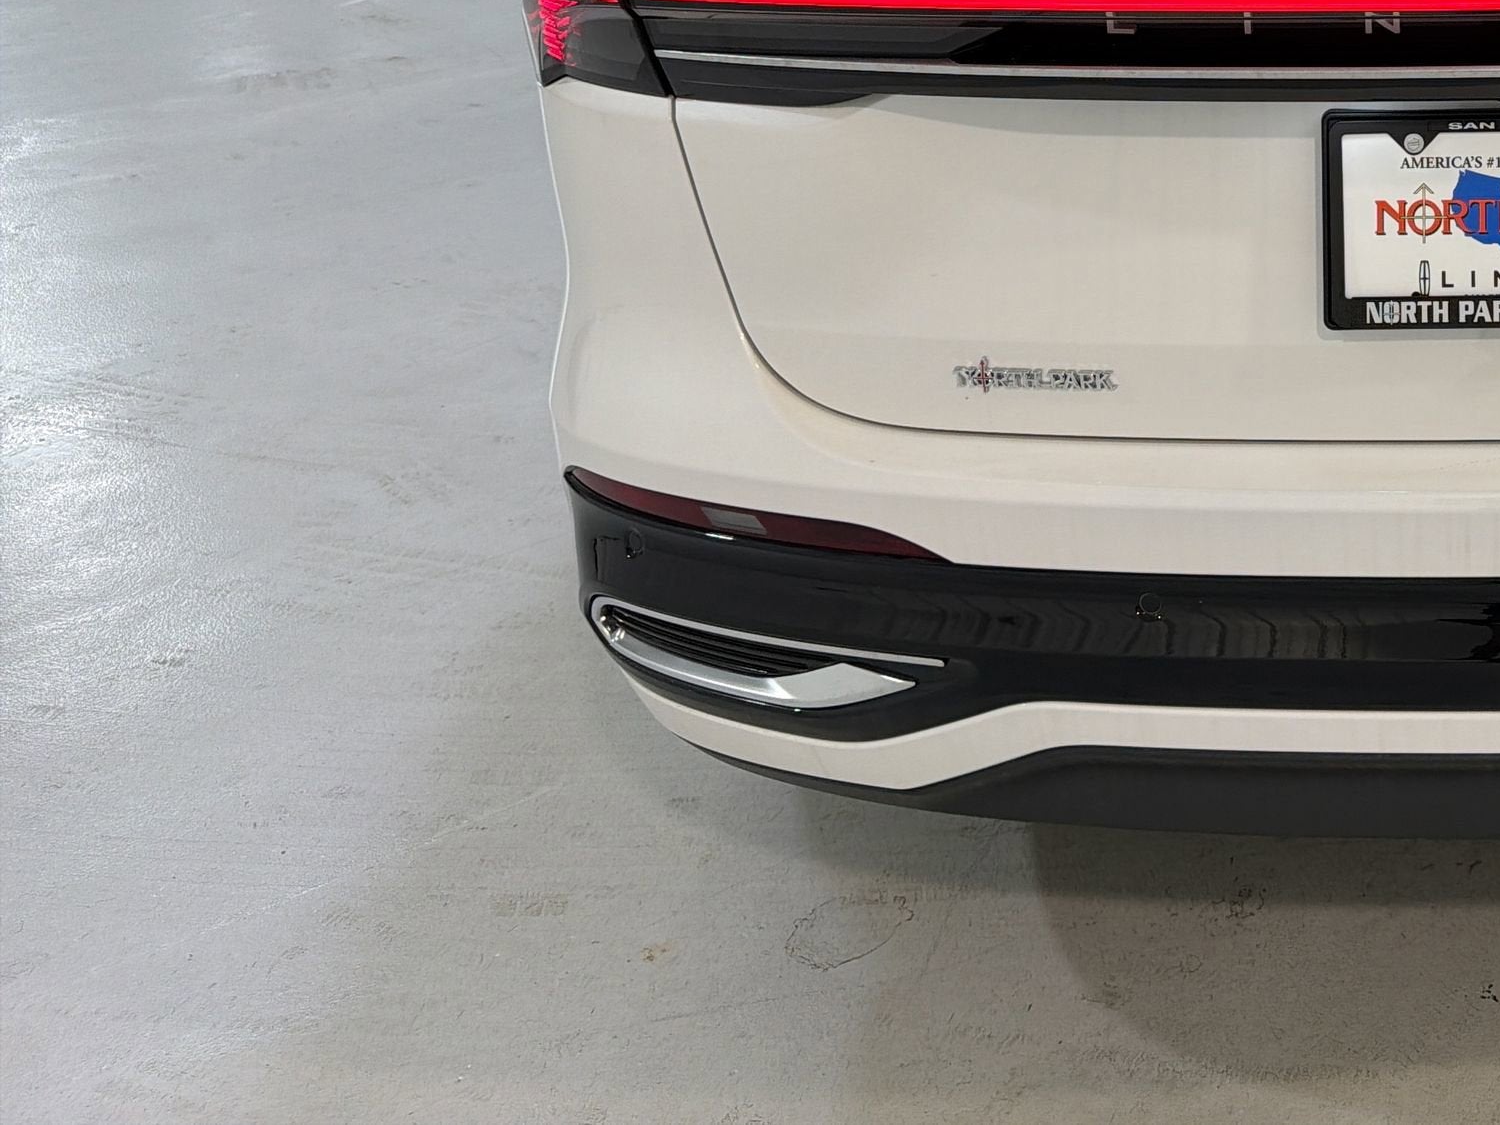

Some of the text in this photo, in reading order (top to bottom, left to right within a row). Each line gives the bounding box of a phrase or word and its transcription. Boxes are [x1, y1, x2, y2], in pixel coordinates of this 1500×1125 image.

[1448, 121, 1495, 130] SAN
[1400, 156, 1483, 170] AMERICA'S
[1366, 300, 1449, 324] NORTH
[1049, 369, 1119, 391] PARK
